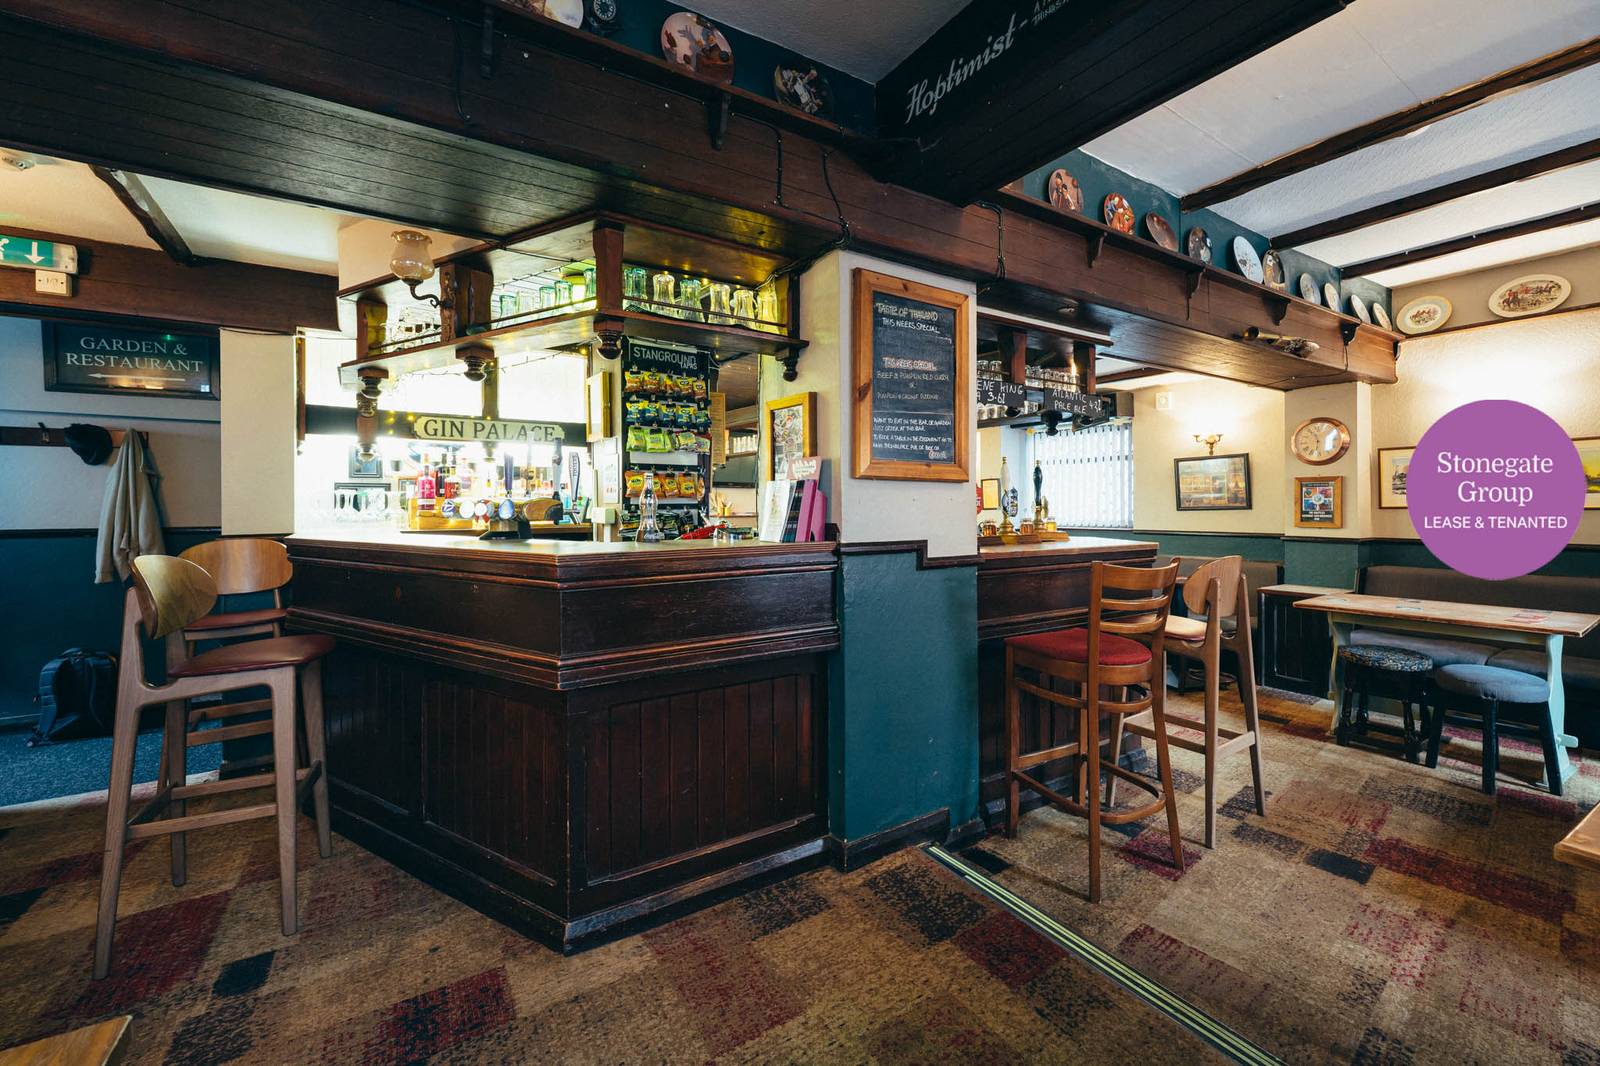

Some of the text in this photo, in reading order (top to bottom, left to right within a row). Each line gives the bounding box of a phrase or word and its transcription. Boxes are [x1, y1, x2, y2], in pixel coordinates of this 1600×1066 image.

[904, 12, 1016, 124] Hoptimist
[915, 322, 941, 334] SPECIAL
[80, 337, 188, 355] GARDEN &
[66, 353, 204, 372] RESTAURANT
[633, 346, 697, 365] STANGROUND
[1000, 382, 1024, 395] KING
[1052, 389, 1087, 403] ATLANTIC
[1054, 400, 1072, 411] PALE
[424, 419, 556, 442] GIN PALACE
